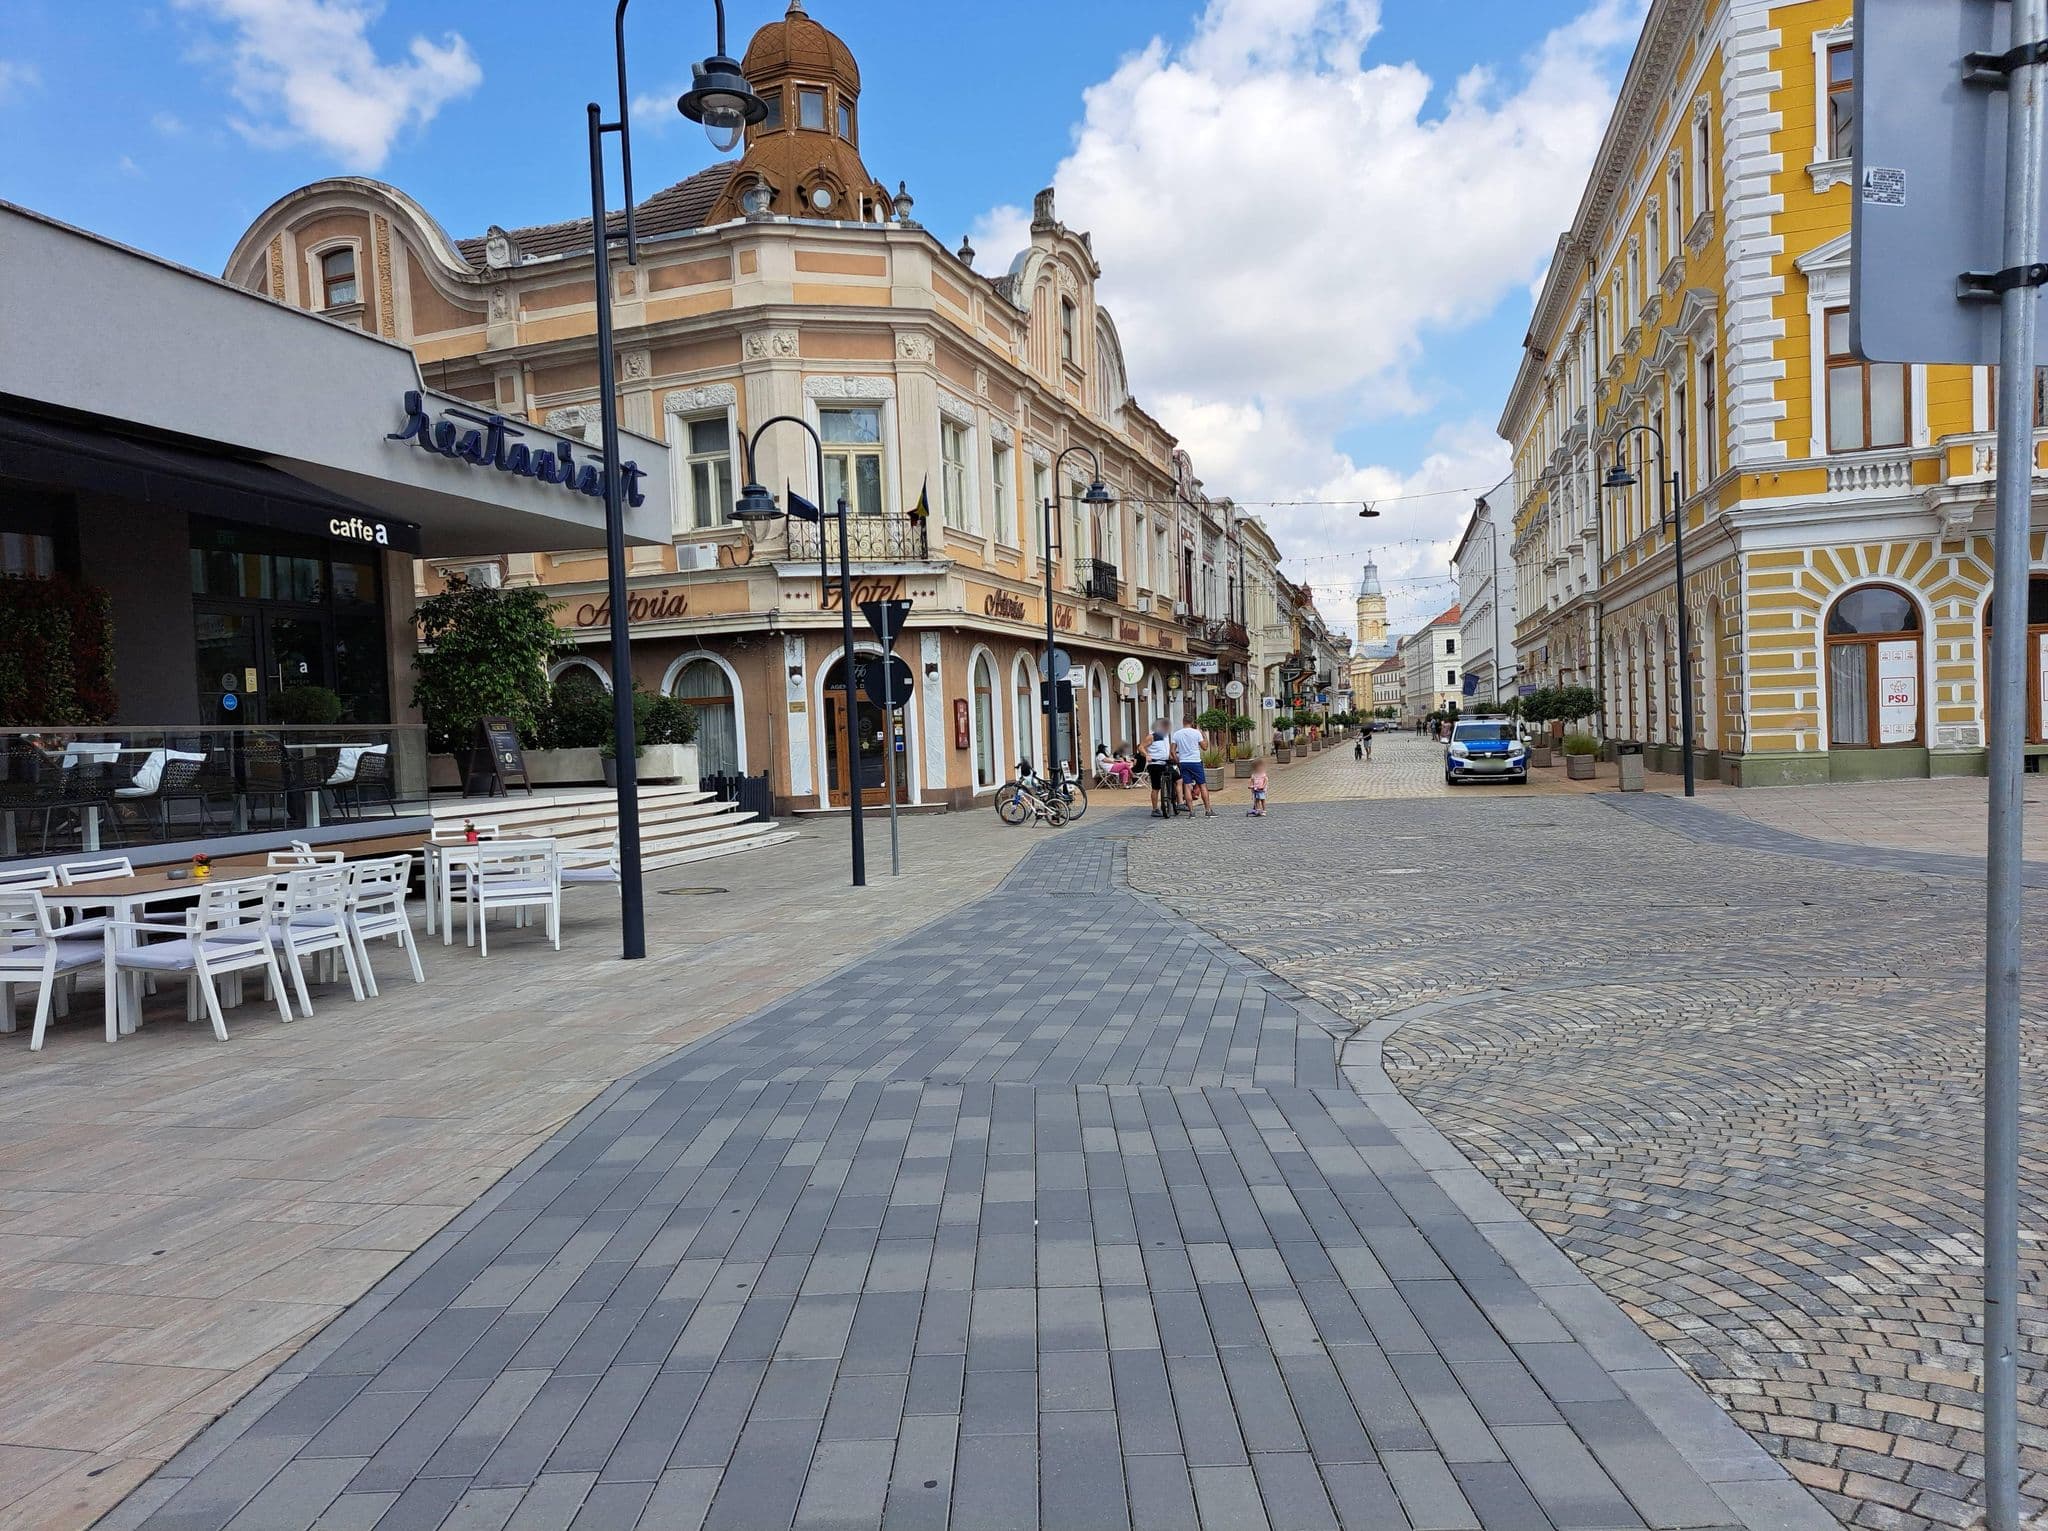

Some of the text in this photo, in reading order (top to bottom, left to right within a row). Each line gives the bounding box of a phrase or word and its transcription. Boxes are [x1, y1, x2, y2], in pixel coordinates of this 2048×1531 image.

[385, 390, 648, 507] restaurat
[330, 517, 389, 545] caffe a
[576, 589, 688, 627] Atoria
[300, 662, 308, 673] a
[1888, 694, 1909, 704] PSD
